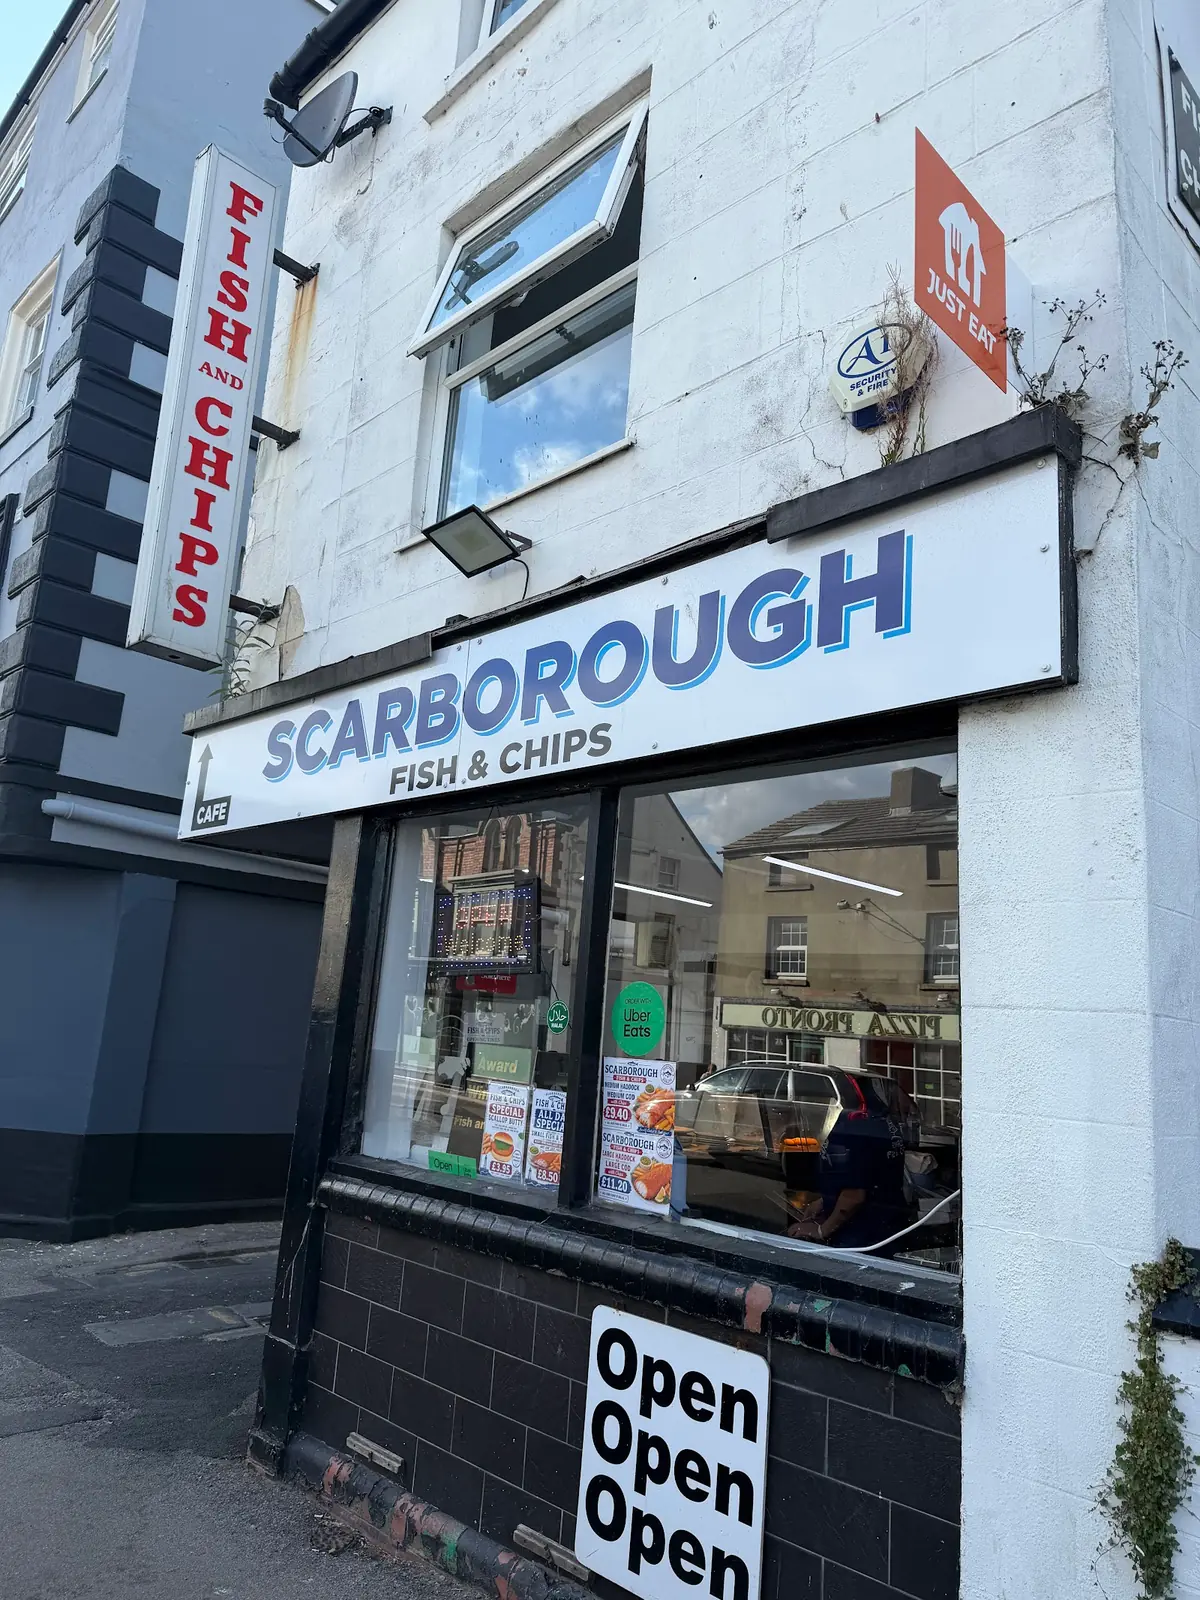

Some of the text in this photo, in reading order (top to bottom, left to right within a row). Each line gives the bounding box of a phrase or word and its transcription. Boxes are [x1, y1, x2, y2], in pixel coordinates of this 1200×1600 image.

[927, 267, 996, 355] JUST EAT
[850, 367, 897, 391] SECURITY
[857, 380, 889, 397] & FIRE
[173, 181, 263, 628] FISH AND CHIPS
[262, 529, 911, 783] SCARBOROUGH
[389, 722, 612, 795] FISH & CHIPS
[197, 802, 228, 825] CAFE
[624, 1008, 651, 1022] Uber
[624, 1024, 651, 1038] Eats
[478, 1056, 518, 1073] Award
[604, 1064, 658, 1078] SCARBOROUGH
[536, 1098, 549, 1108] FISH
[491, 1105, 522, 1118] SPECIAL
[538, 1110, 565, 1122] ALL DA
[605, 1107, 628, 1120] £9.40
[536, 1119, 564, 1132] SPECIA
[602, 1132, 654, 1150] SCARBOROUGH
[434, 1158, 453, 1171] Open
[491, 1161, 511, 1174] £3.95
[537, 1169, 558, 1183] £8.50
[601, 1177, 628, 1192] £11.20
[597, 1327, 758, 1443] Open
[591, 1400, 754, 1527] Open
[585, 1474, 749, 1600] Open
